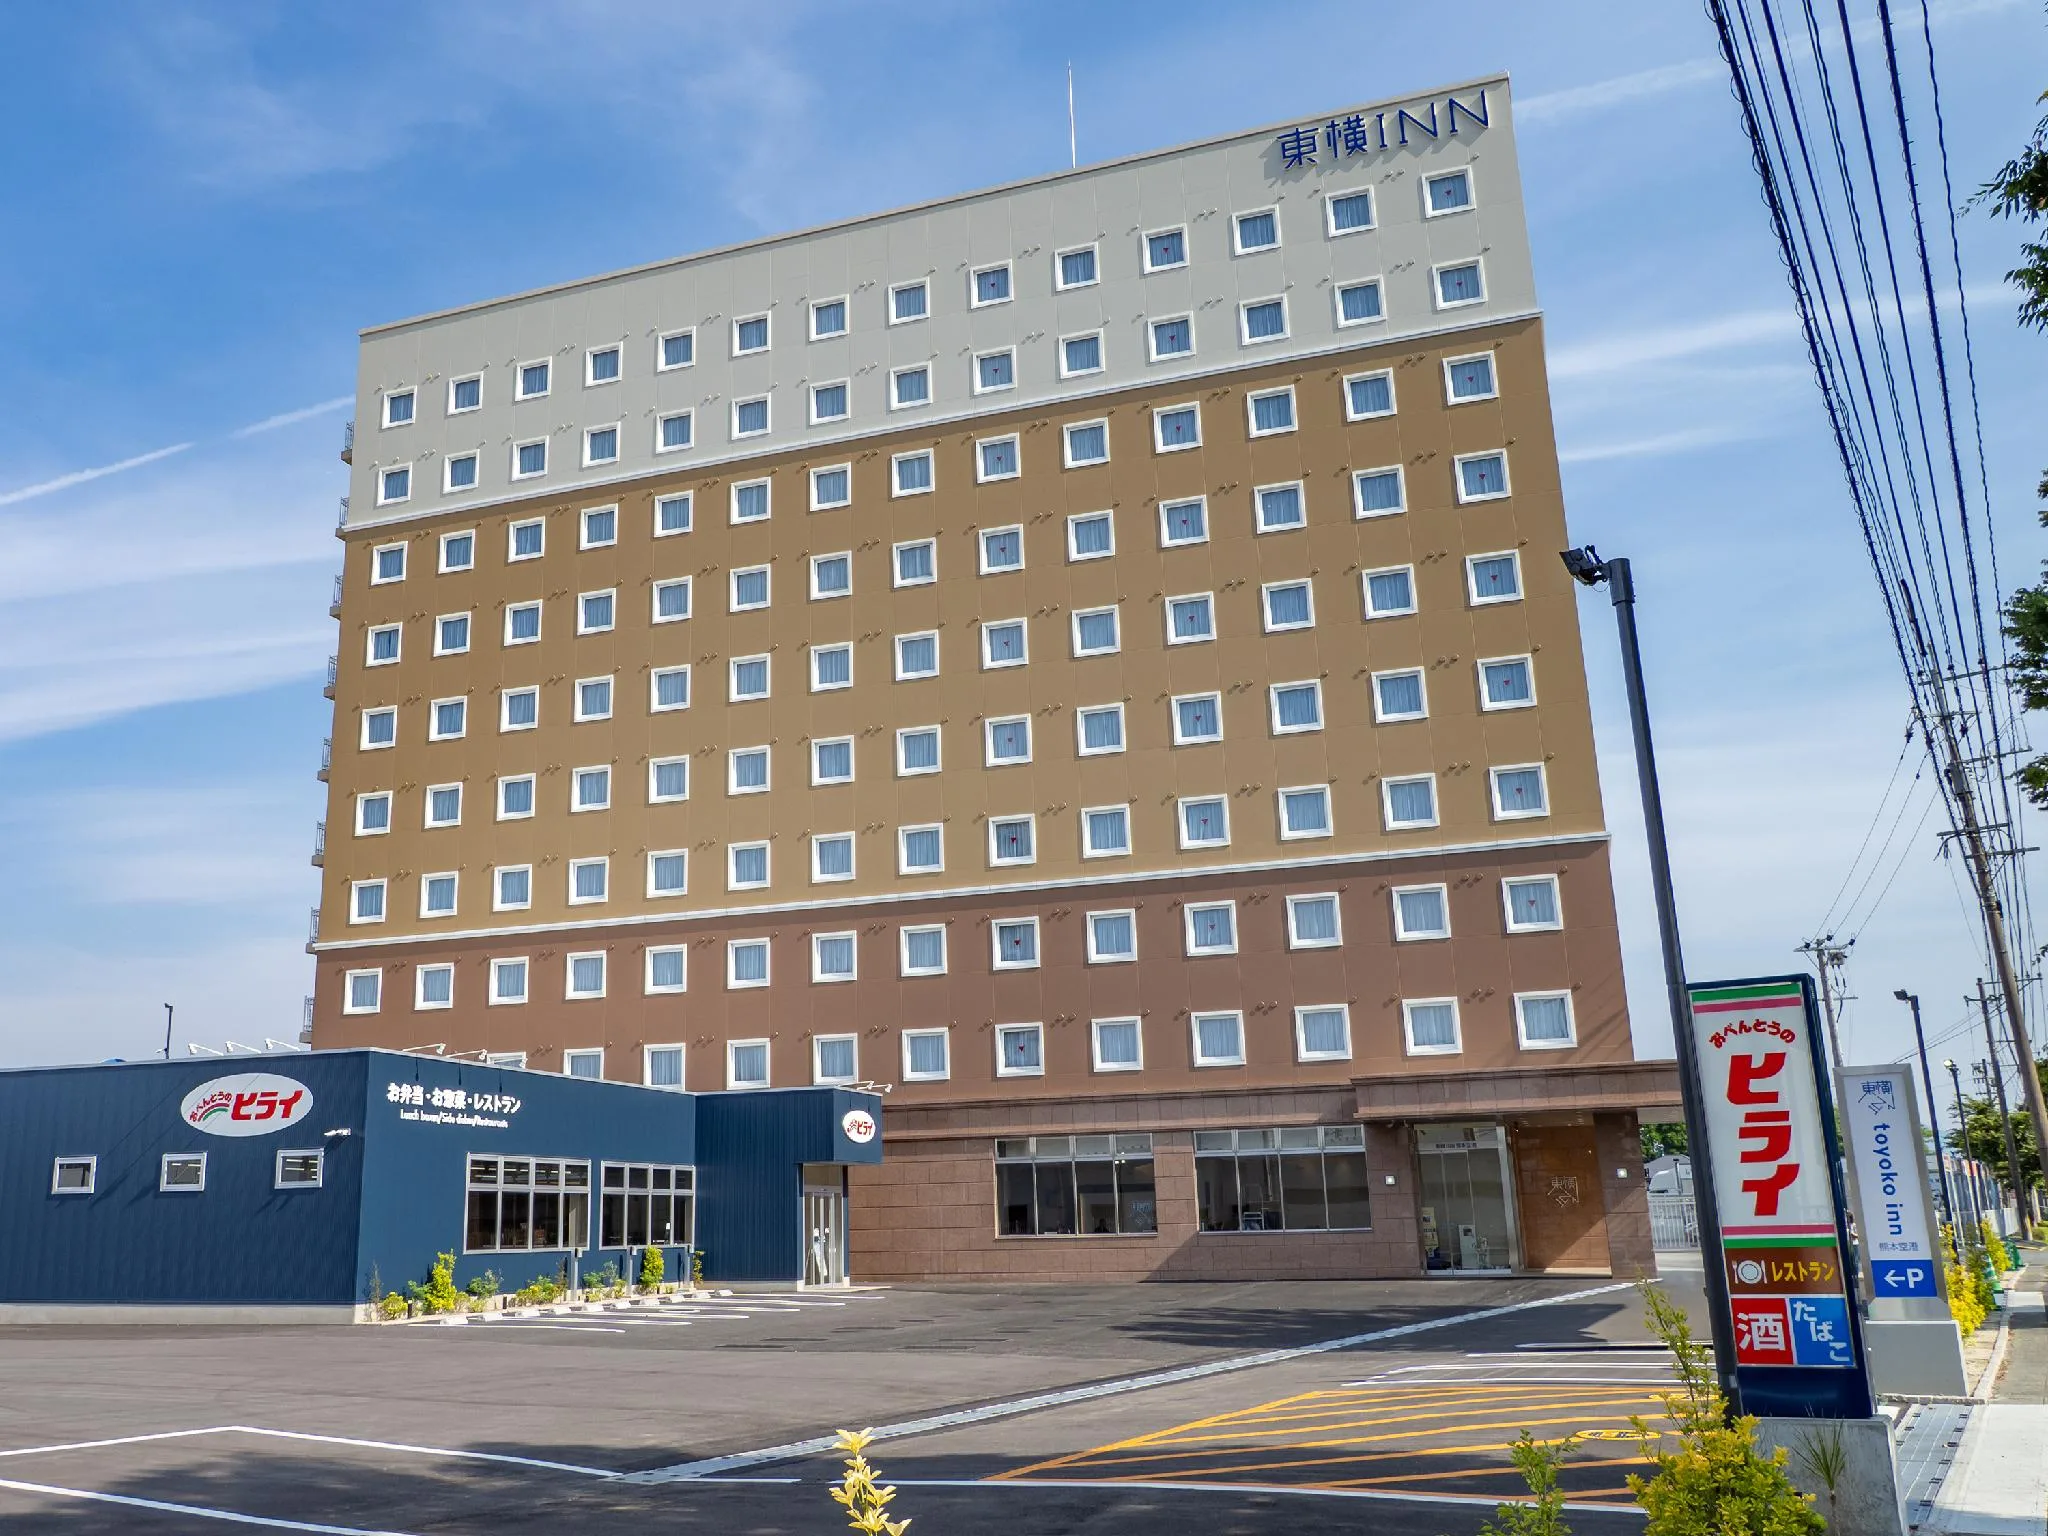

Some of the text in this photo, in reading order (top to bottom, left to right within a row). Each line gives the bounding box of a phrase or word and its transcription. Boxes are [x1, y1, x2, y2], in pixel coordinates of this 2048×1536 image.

[1709, 1018, 1796, 1049] おべんとうの
[231, 1090, 304, 1120] ヒライ
[1726, 1052, 1800, 1217] ヒライ
[1873, 1122, 1904, 1236] toyoko inn
[1771, 1261, 1835, 1282] レストラン
[1906, 1268, 1924, 1289] P
[1736, 1312, 1786, 1351] 酒
[1793, 1300, 1850, 1362] たばこ
